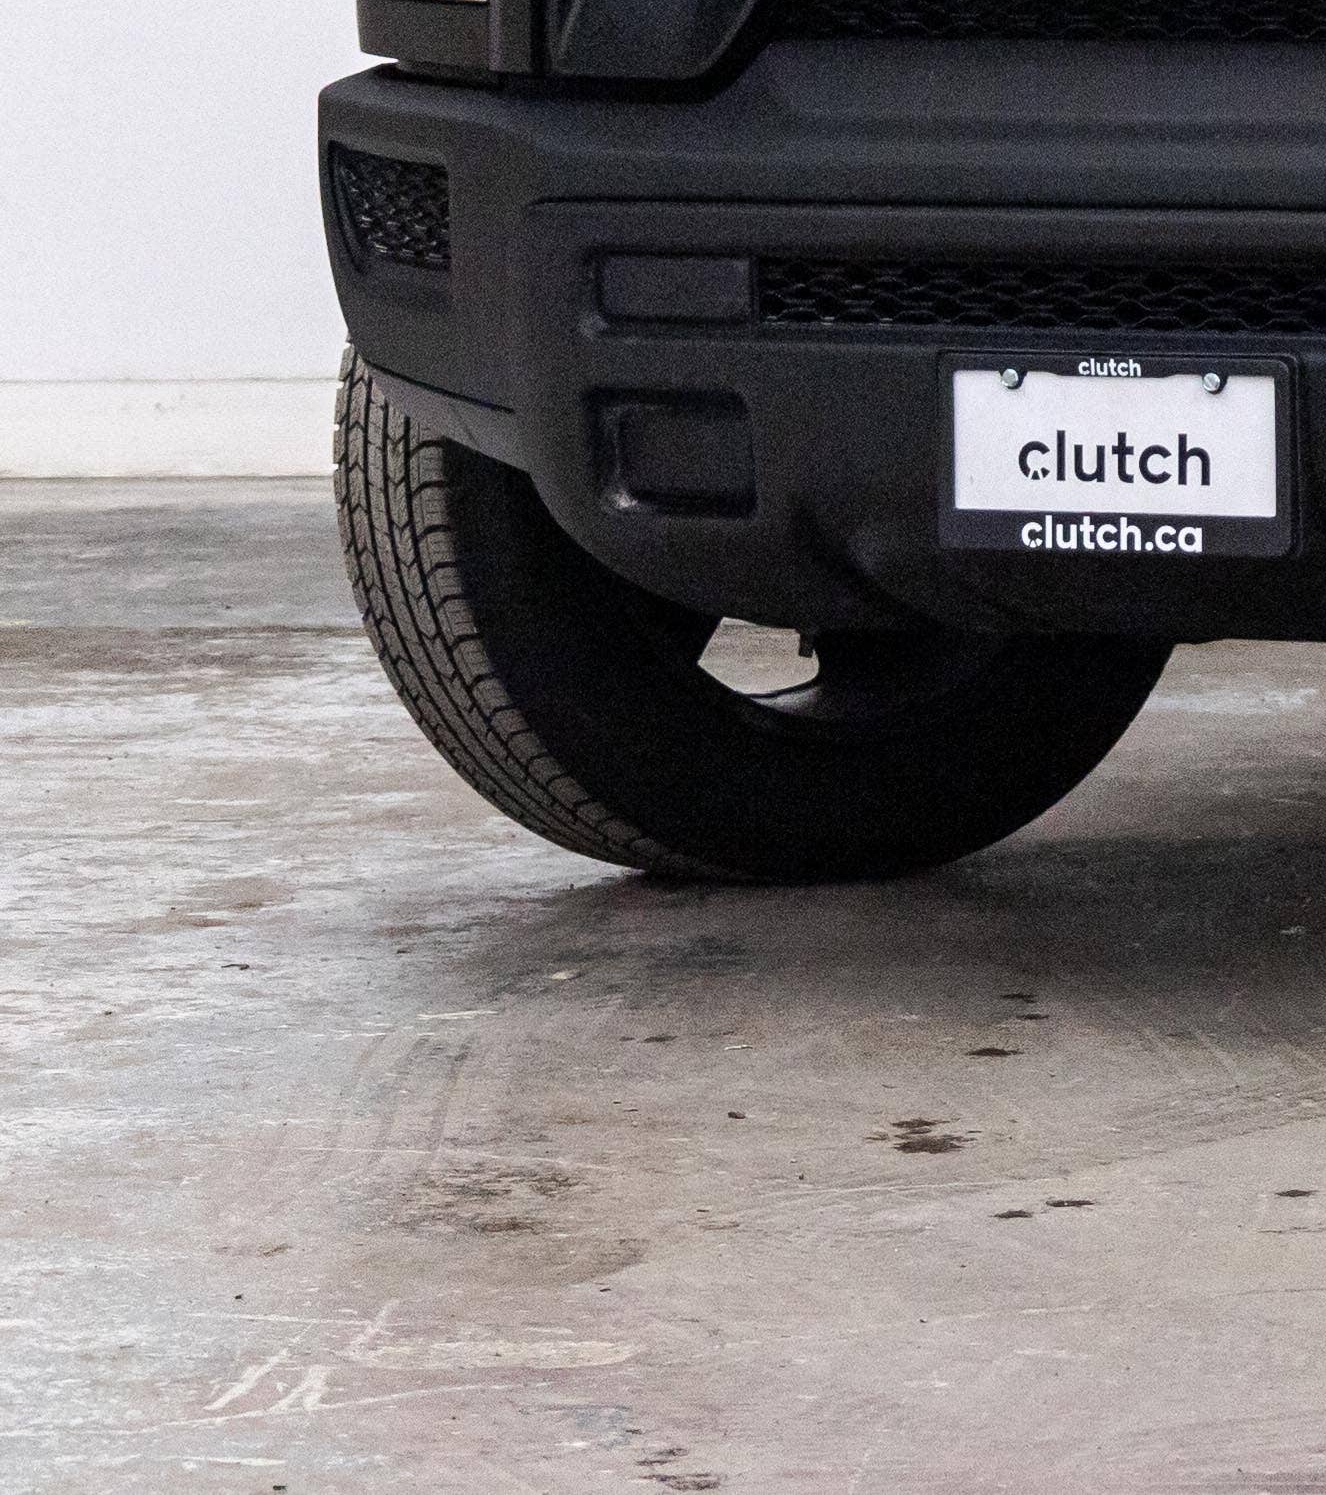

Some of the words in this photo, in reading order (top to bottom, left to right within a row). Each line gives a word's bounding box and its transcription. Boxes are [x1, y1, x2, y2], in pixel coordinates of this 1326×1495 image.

[1077, 358, 1142, 378] clutch
[1018, 430, 1211, 486] clutch
[1021, 515, 1203, 553] clutch.ca
